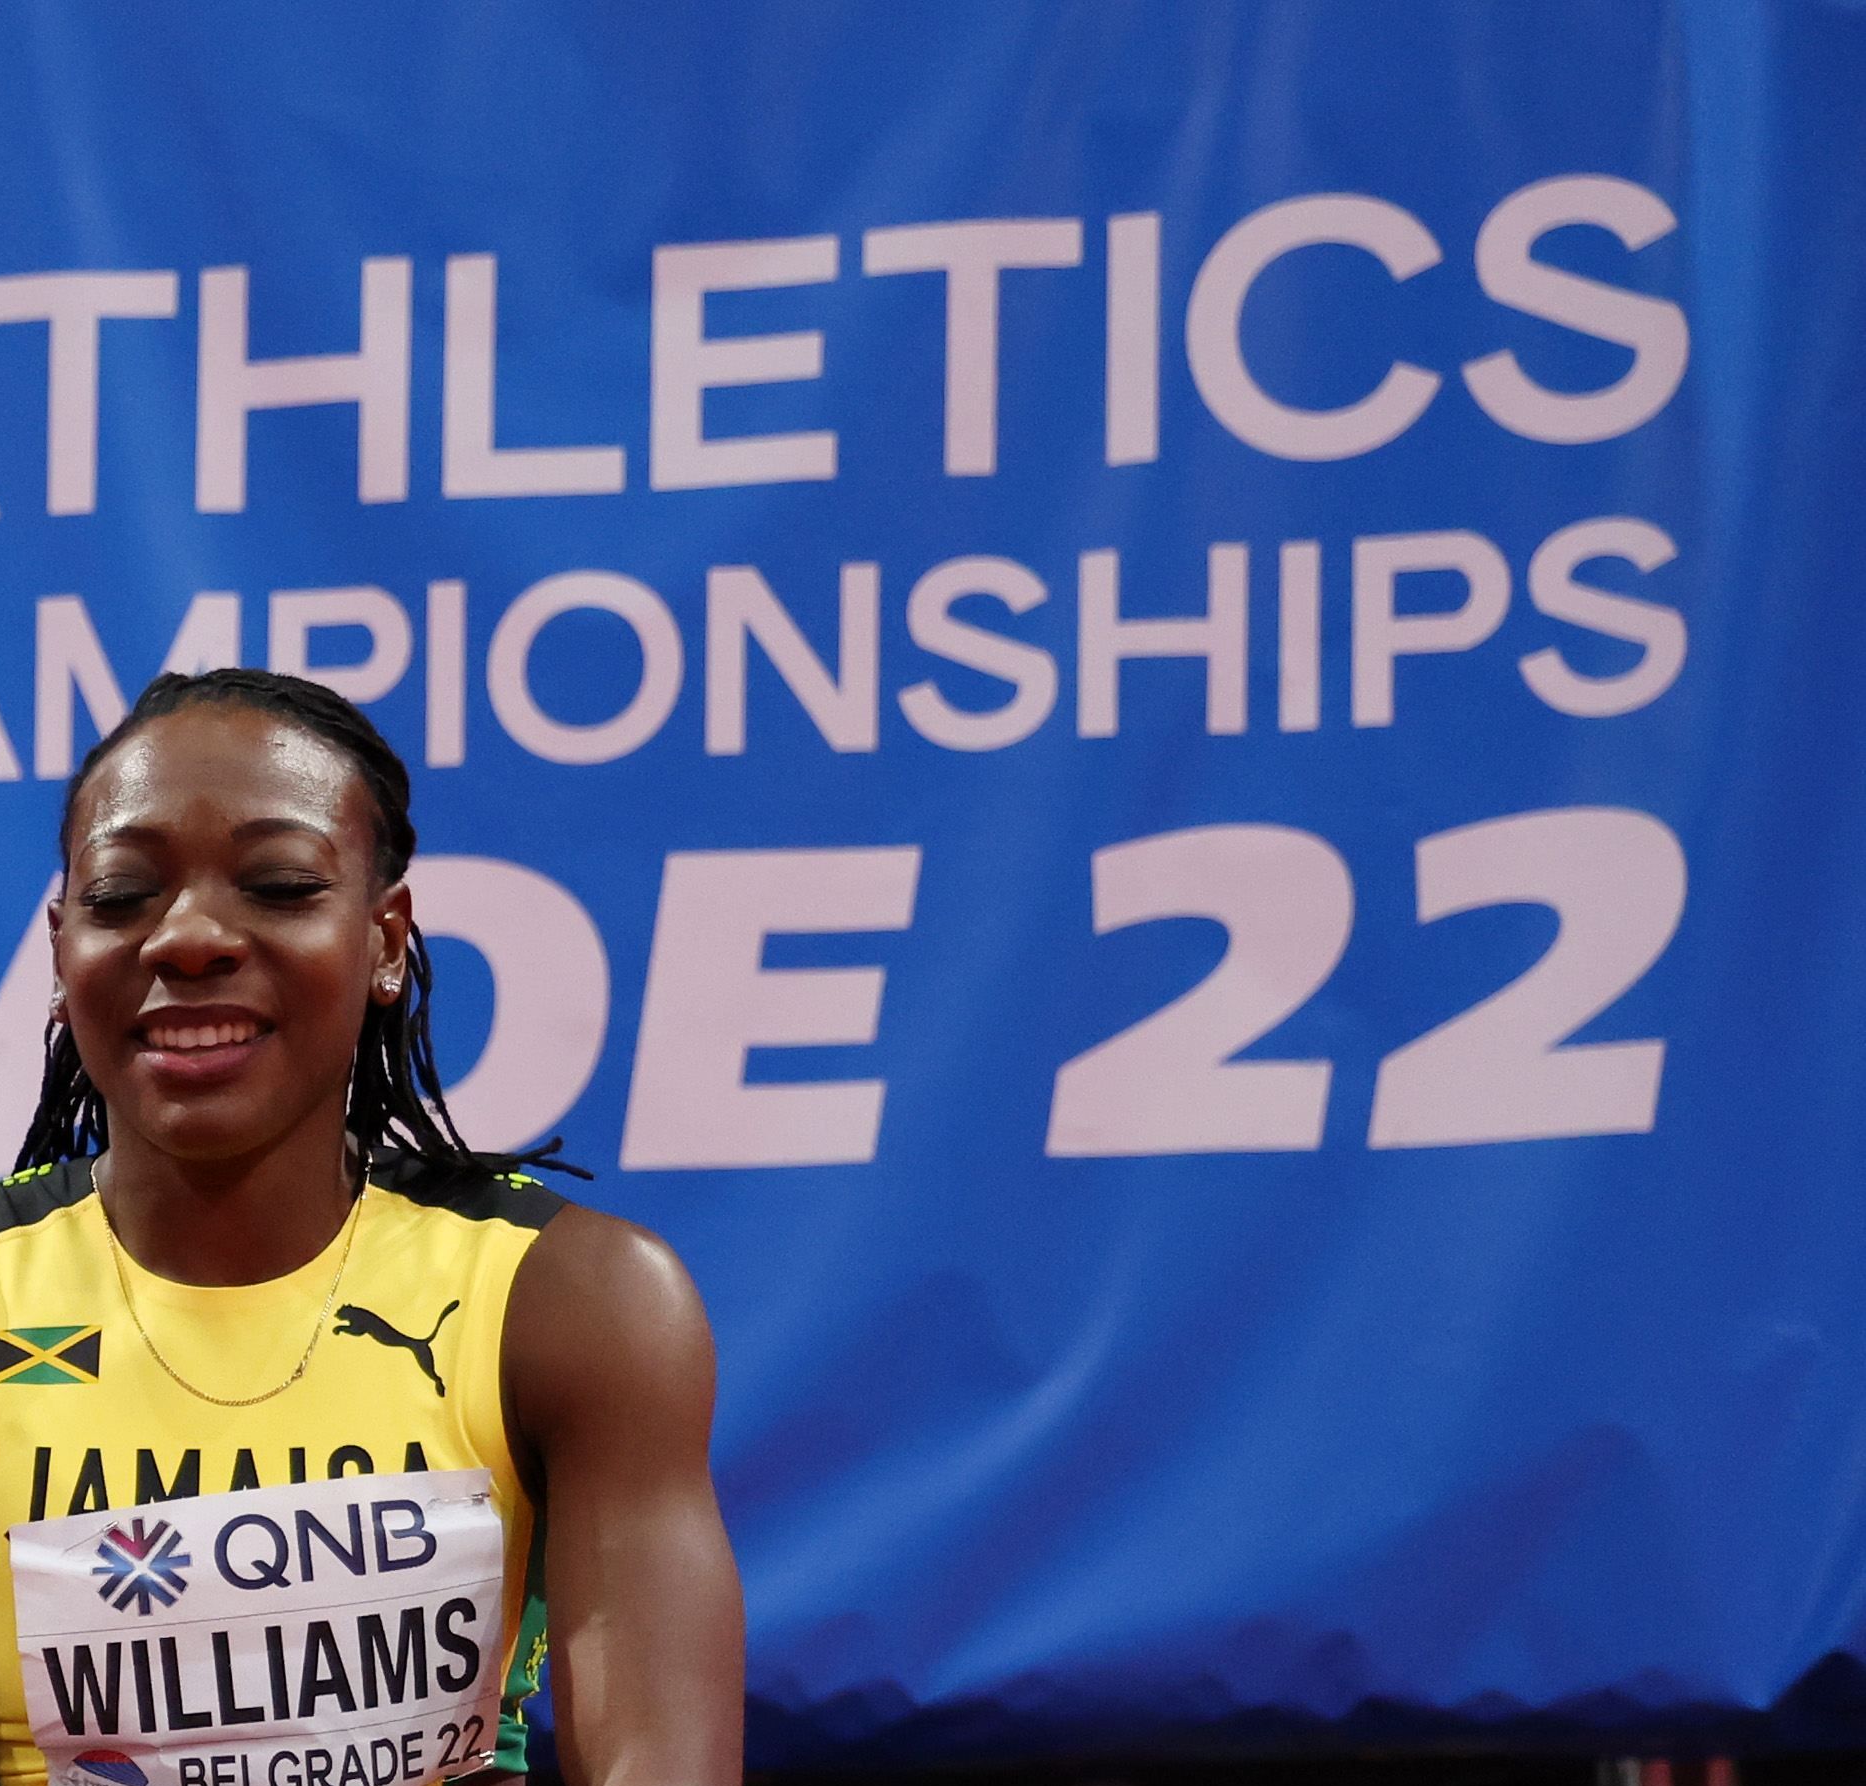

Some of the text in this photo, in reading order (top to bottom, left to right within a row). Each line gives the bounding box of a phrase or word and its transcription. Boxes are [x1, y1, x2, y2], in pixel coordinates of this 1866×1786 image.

[1045, 806, 1686, 1157] 22
[213, 1499, 437, 1591] QNB
[41, 1596, 481, 1736] WILLIAMS
[435, 1715, 484, 1770] 22
